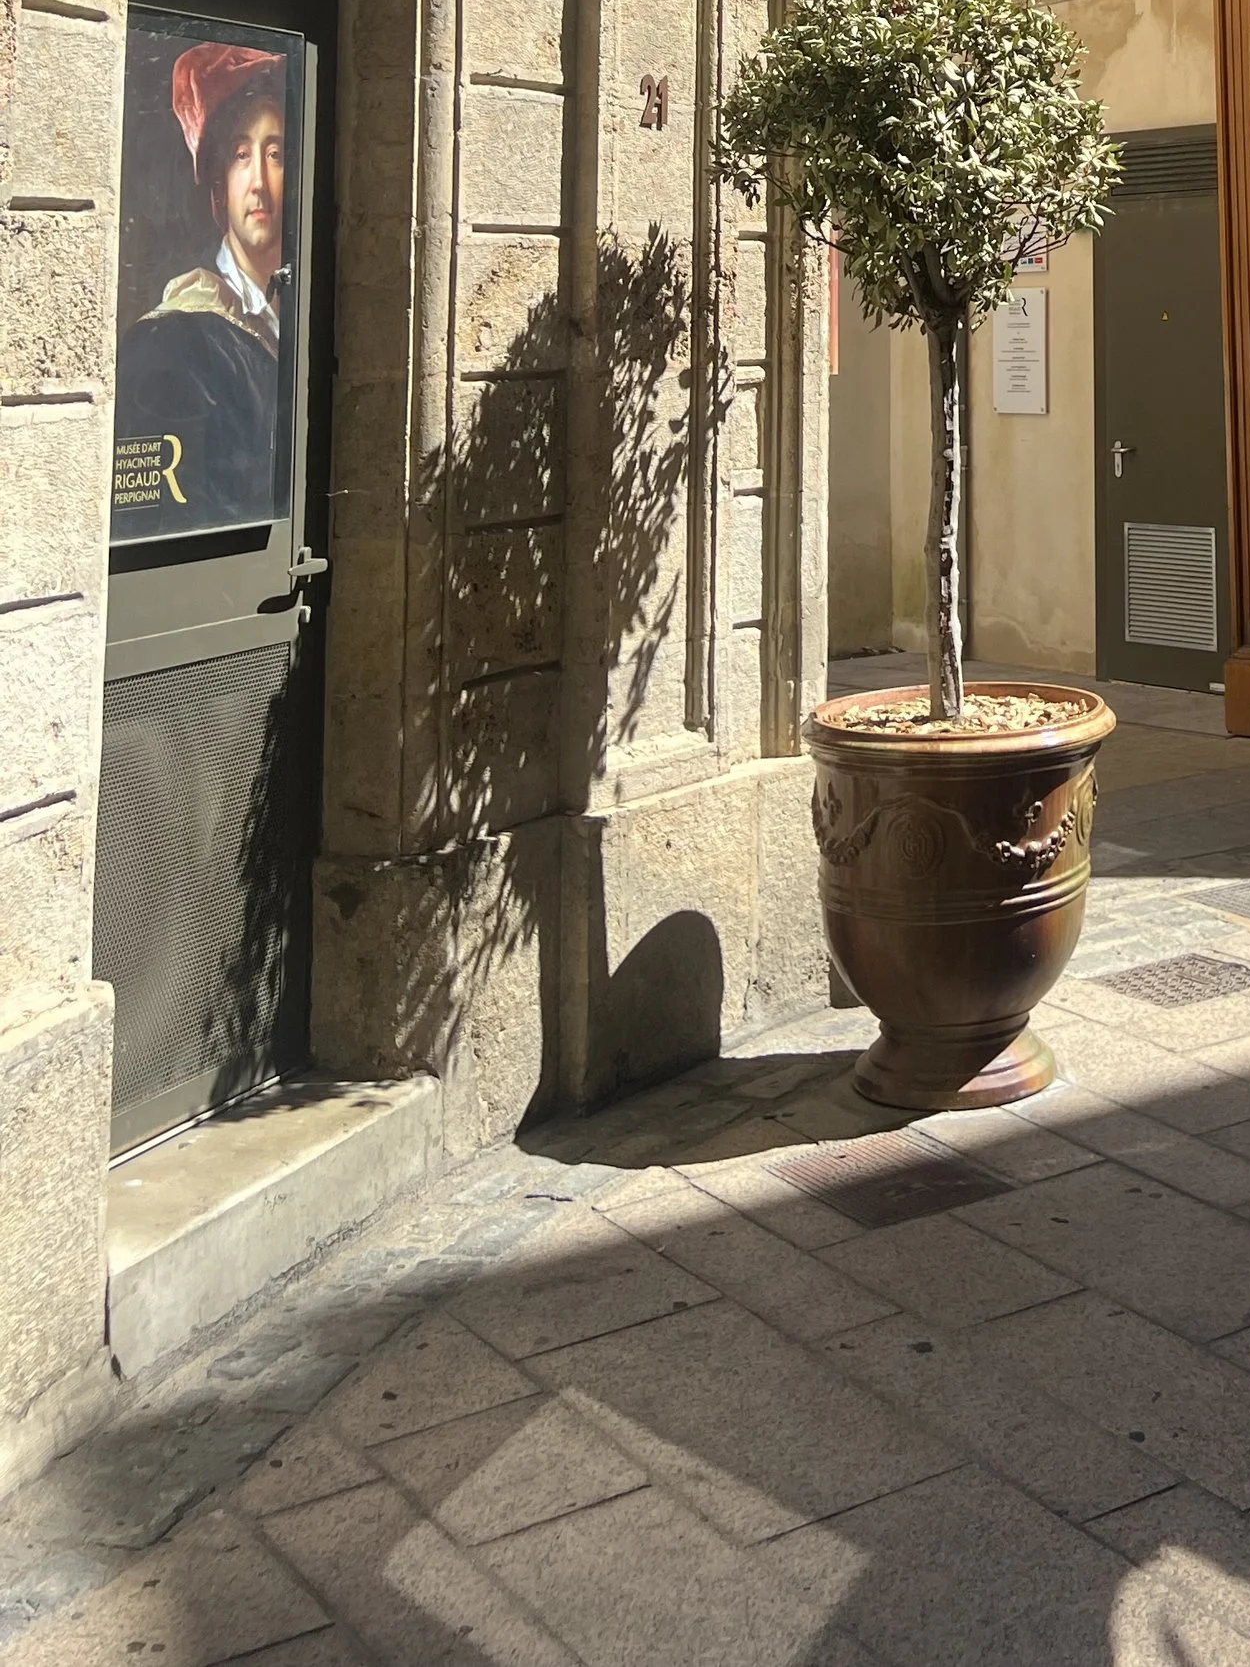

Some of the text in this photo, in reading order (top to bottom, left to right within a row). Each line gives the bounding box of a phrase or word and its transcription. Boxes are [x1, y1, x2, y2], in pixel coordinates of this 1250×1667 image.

[639, 74, 669, 130] 21
[116, 441, 162, 454] MUSÉE D'ART
[115, 456, 161, 470] HYACINTHE
[115, 470, 161, 490] RIGAUD
[114, 489, 160, 504] PERPIGNAN
